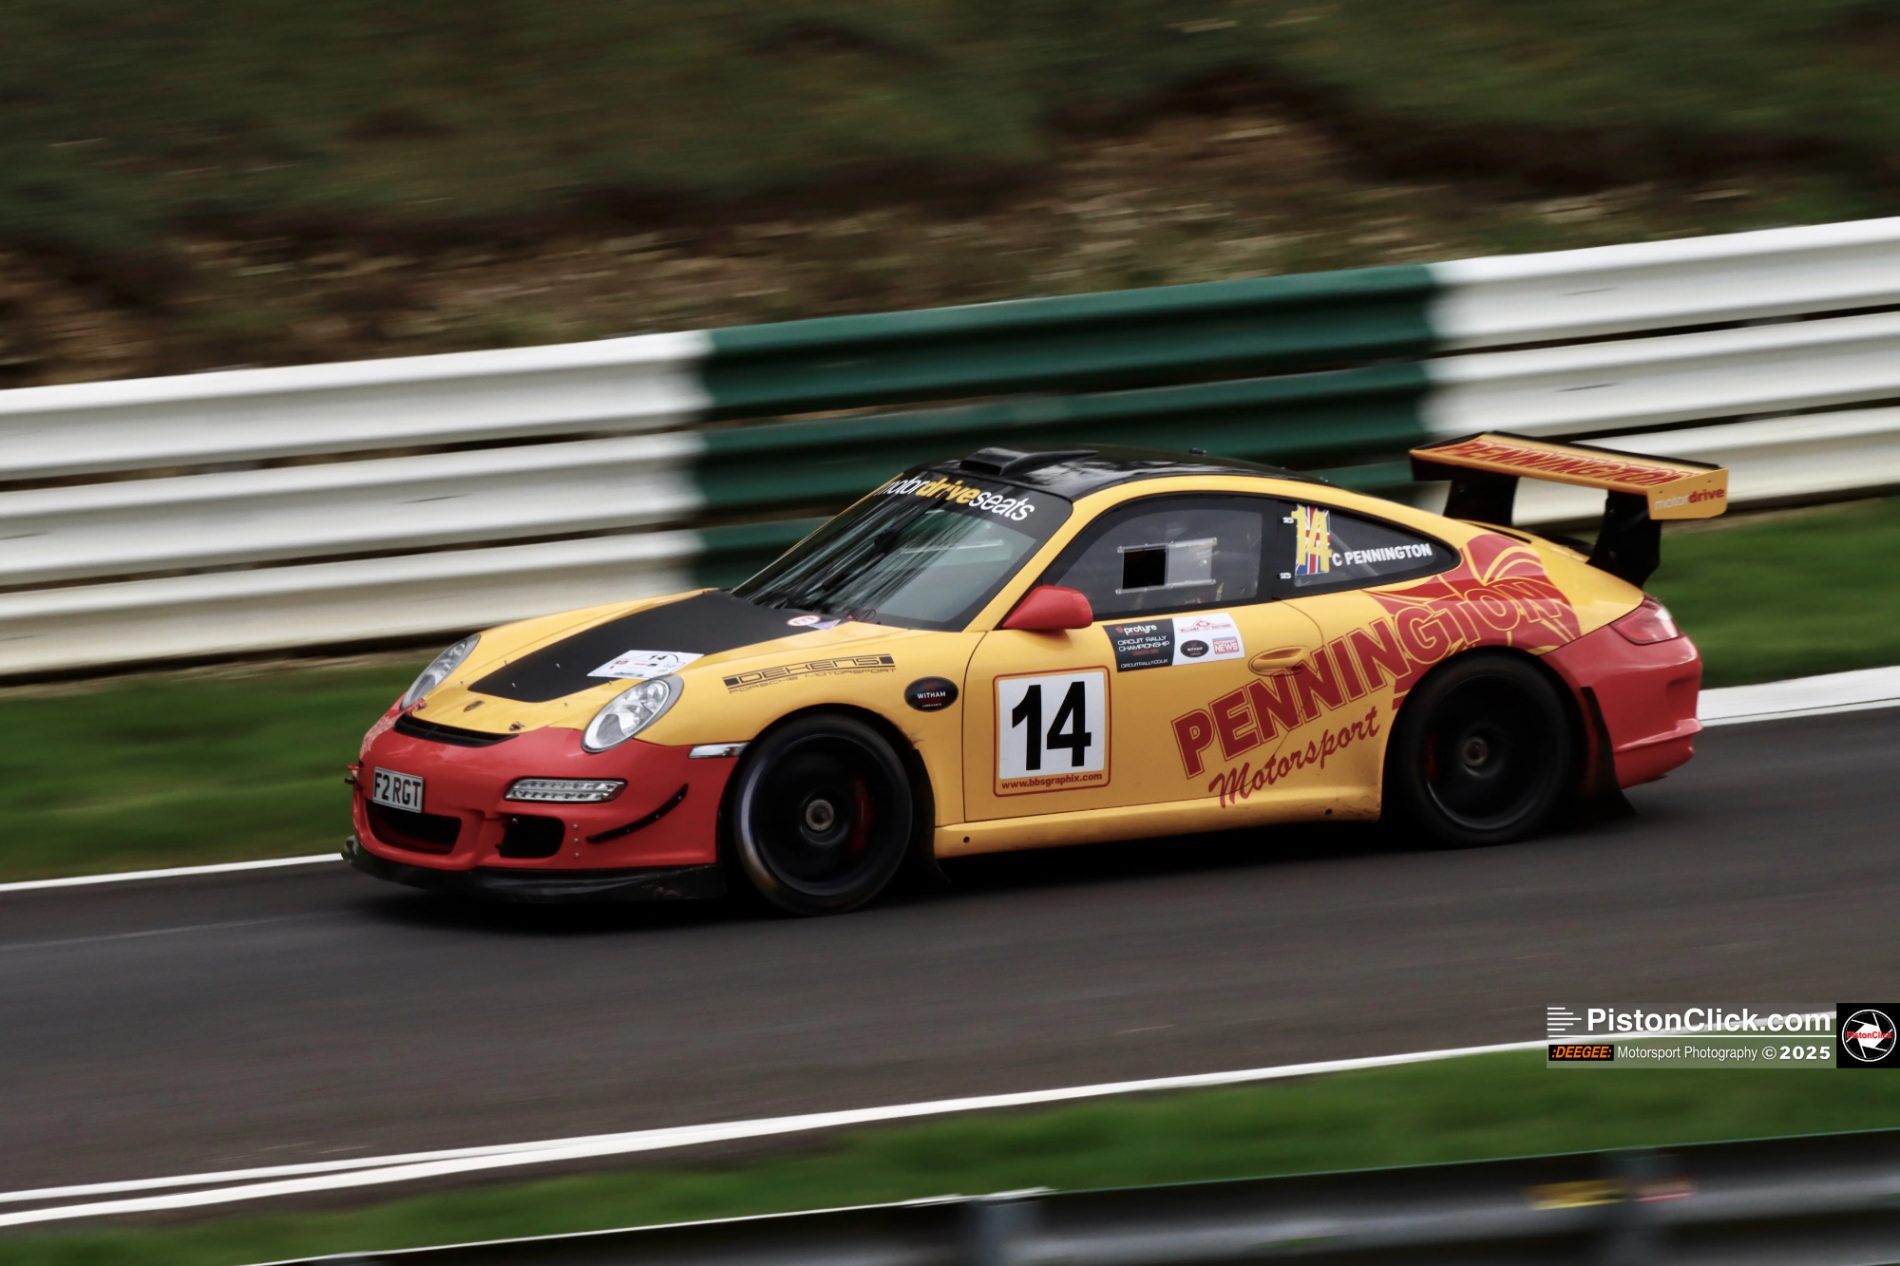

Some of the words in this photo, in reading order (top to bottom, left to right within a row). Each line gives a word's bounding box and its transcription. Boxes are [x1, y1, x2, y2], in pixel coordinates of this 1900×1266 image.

[1431, 440, 1704, 487] PENNINGTON
[1291, 504, 1333, 573] 14
[1331, 551, 1343, 567] C
[1344, 543, 1433, 566] PENNINGTON
[1124, 624, 1158, 636] protyre
[917, 691, 946, 700] WITHAM
[1171, 582, 1562, 780] PENNINGTON
[1012, 681, 1092, 771] 14
[1208, 705, 1381, 809] Motorsport
[374, 771, 391, 801] F2
[392, 777, 421, 808] RGT
[1001, 773, 1103, 789] www.bbsgraphix.com
